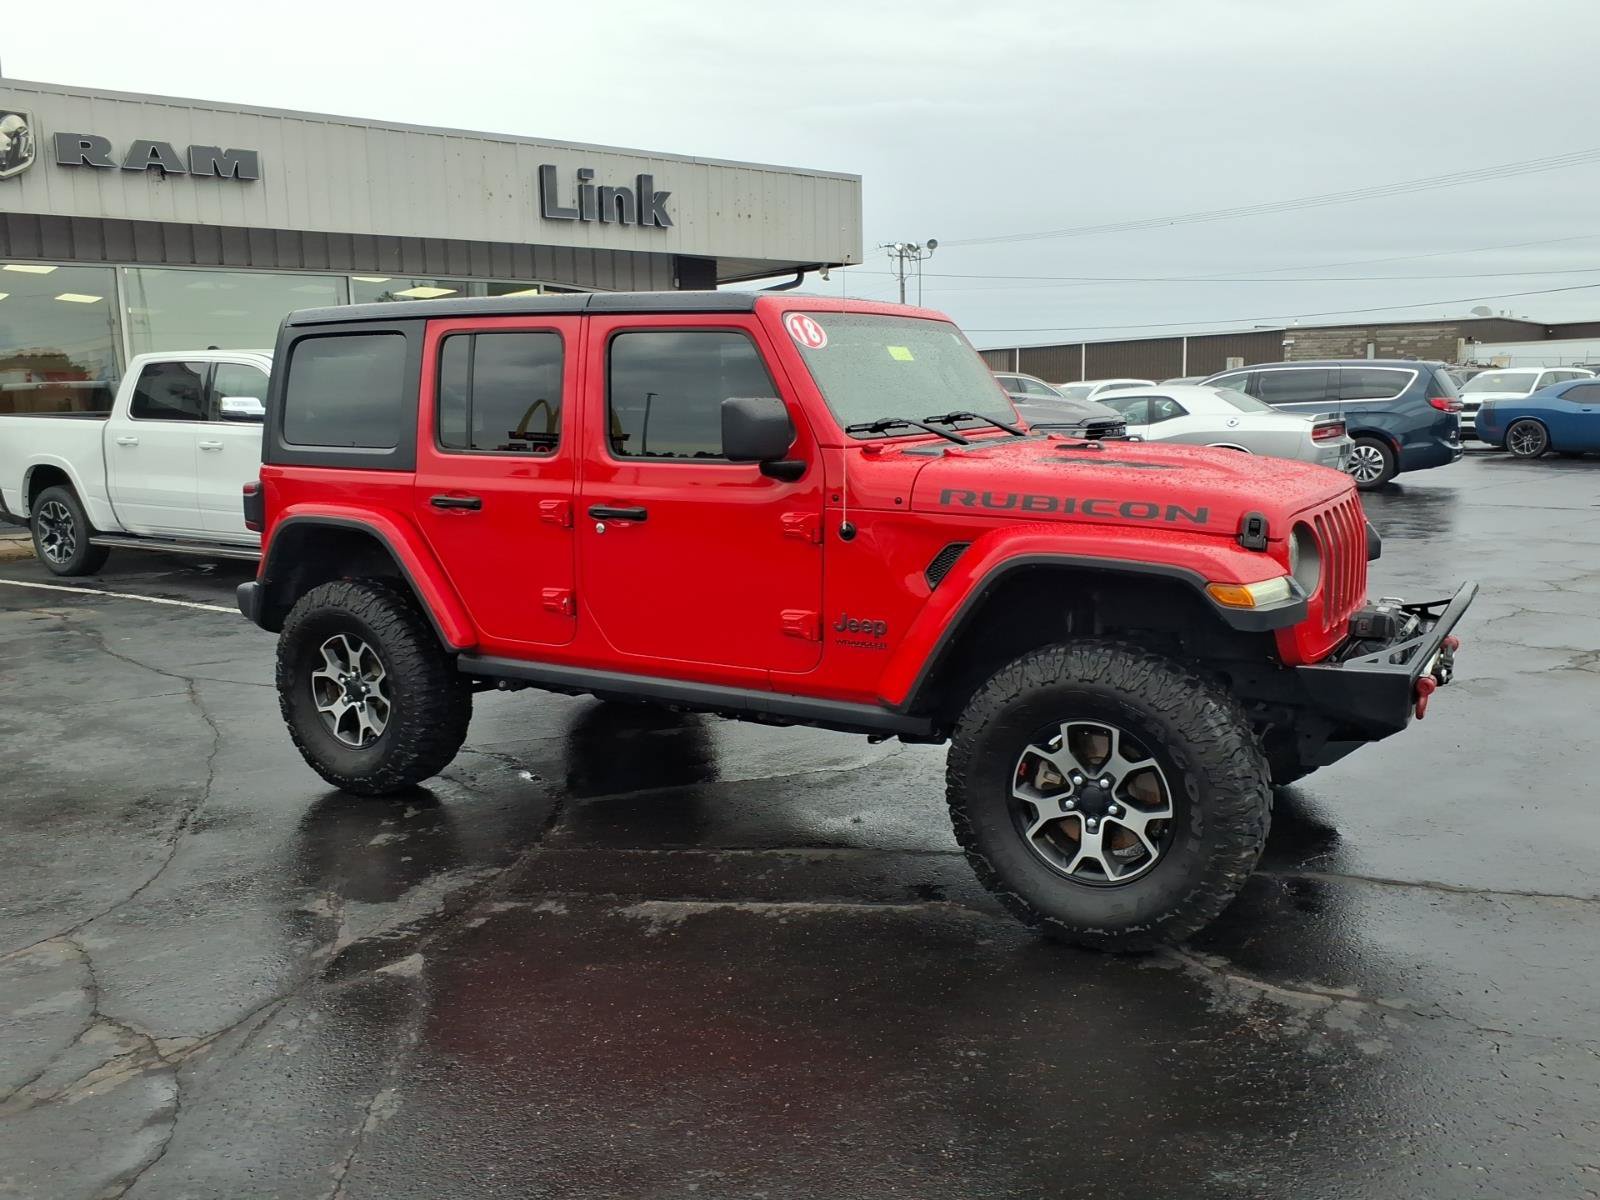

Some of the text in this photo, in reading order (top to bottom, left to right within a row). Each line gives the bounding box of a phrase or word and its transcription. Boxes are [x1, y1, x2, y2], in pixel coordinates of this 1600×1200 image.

[53, 131, 260, 182] RAM
[539, 163, 674, 228] Link
[792, 318, 821, 345] 18
[940, 488, 1209, 525] RUBICON
[832, 611, 887, 638] Jeep
